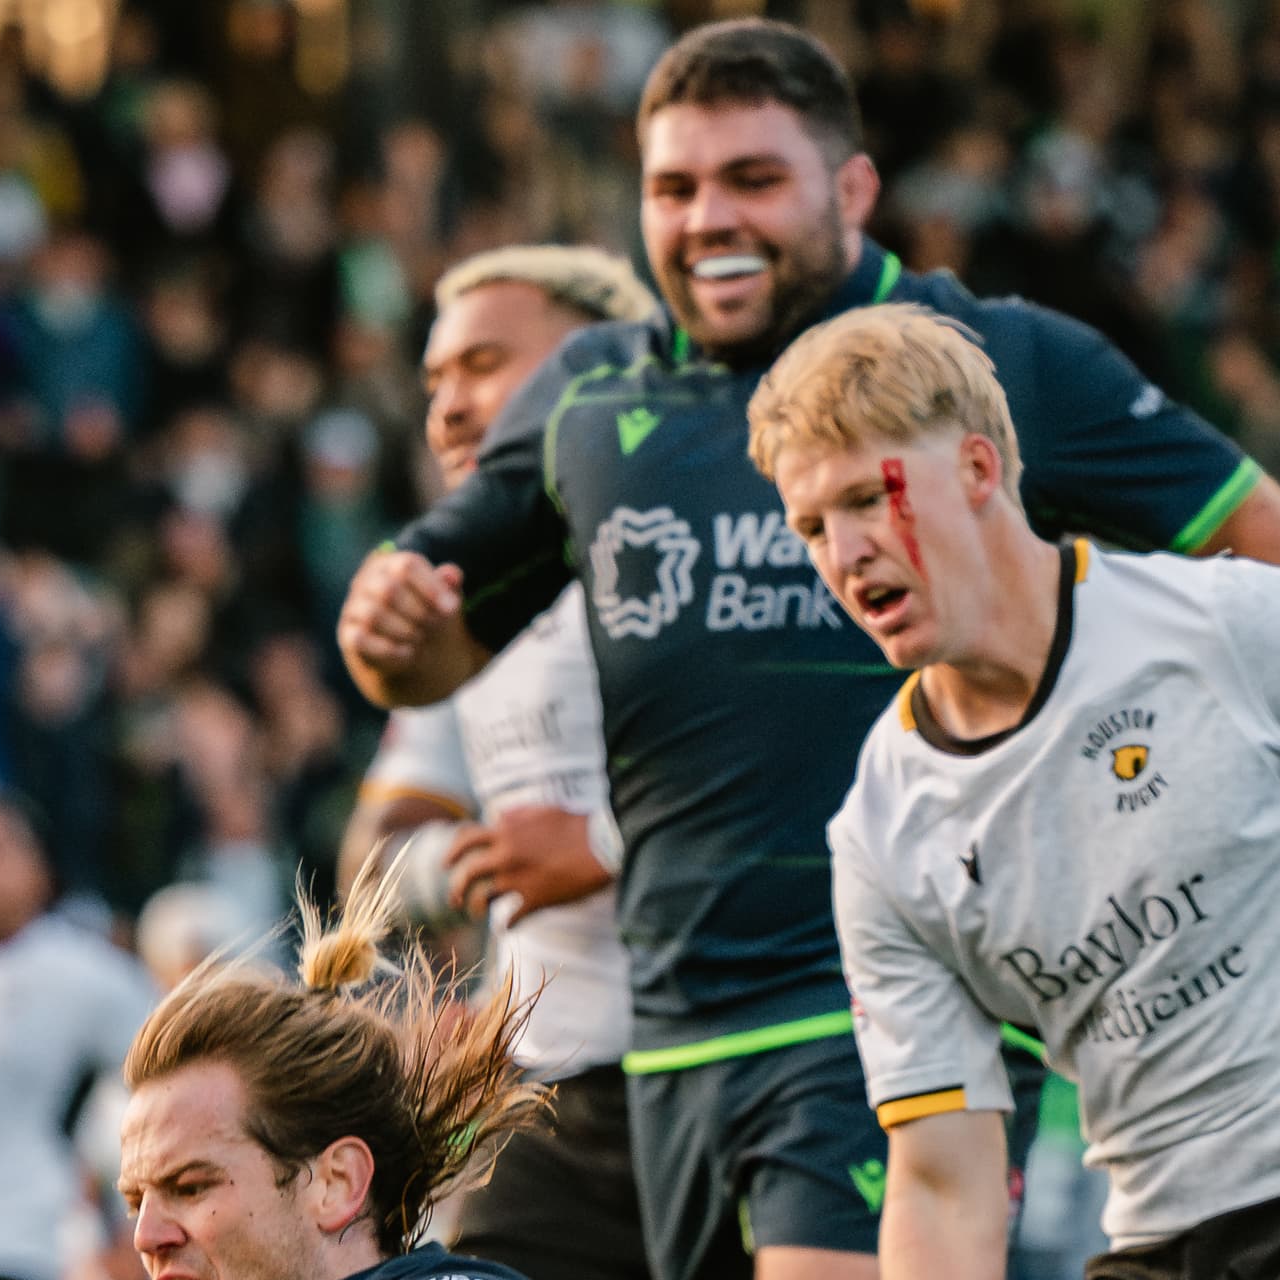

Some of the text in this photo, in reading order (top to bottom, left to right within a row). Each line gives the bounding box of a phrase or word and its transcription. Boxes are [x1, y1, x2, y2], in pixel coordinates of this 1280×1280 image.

[712, 510, 818, 569] Wa
[704, 571, 844, 633] Bank
[1081, 708, 1157, 761] HOUSTON
[1115, 771, 1169, 812] RUGBY
[999, 872, 1210, 1002] Baylor
